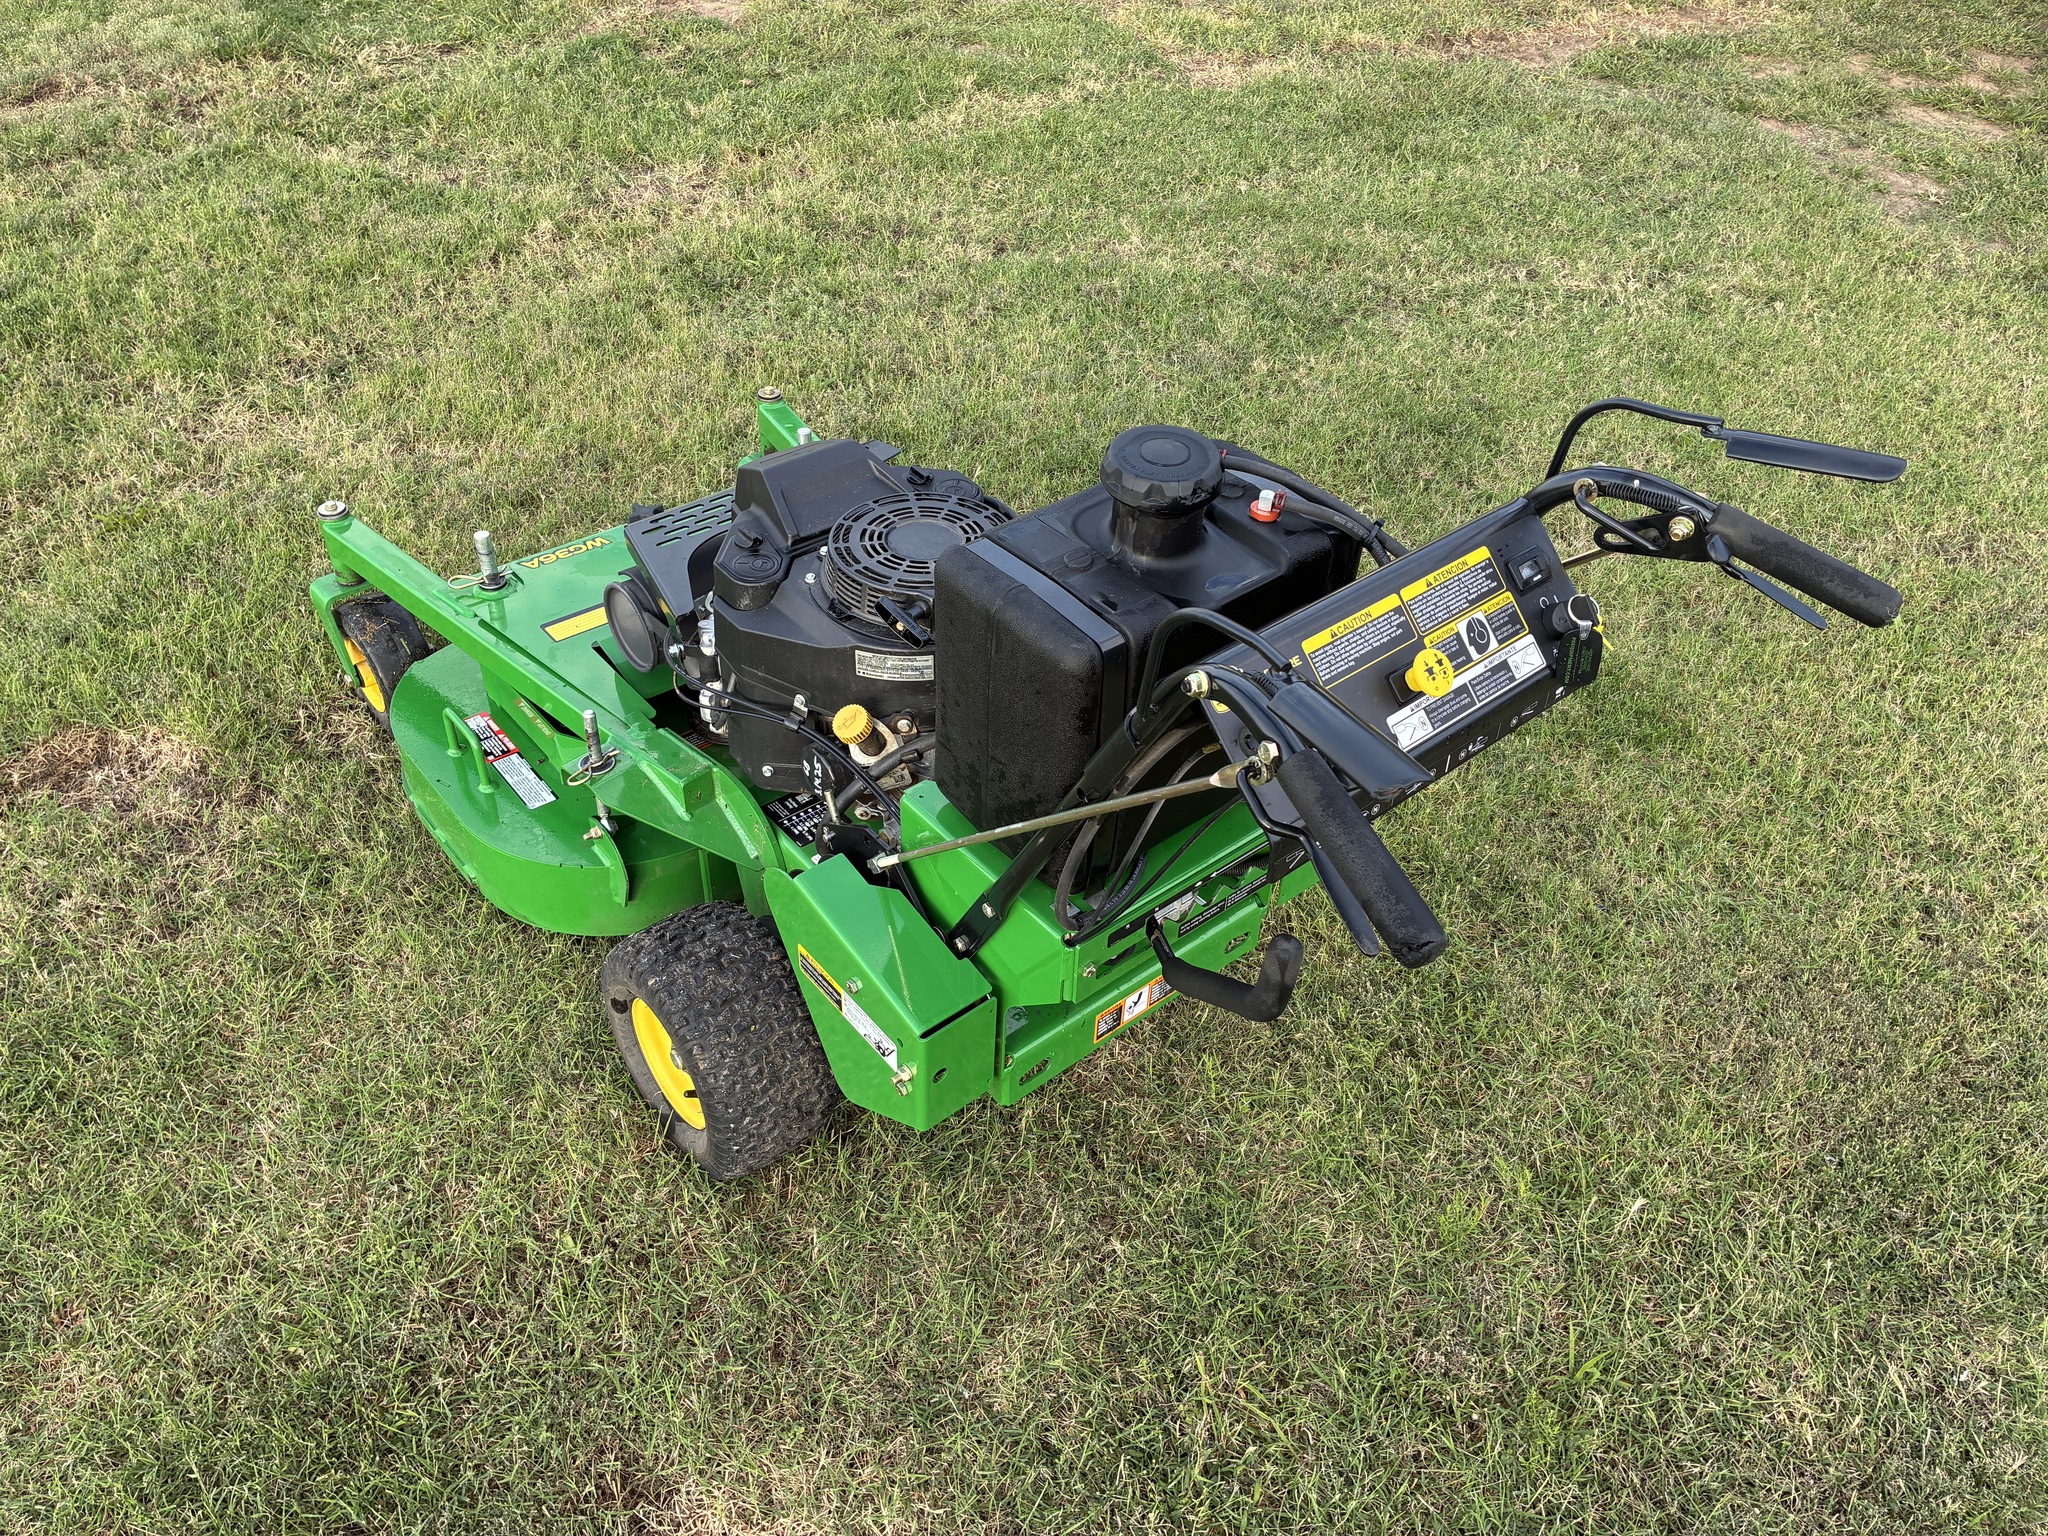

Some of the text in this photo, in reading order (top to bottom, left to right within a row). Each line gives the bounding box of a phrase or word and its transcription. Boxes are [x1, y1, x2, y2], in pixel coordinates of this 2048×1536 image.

[517, 537, 611, 569] WG36A
[1433, 560, 1468, 583] ATENCION
[1487, 595, 1510, 610] ATENCION
[1337, 610, 1372, 634] CAUTION
[1432, 627, 1455, 642] CAUTION
[1487, 645, 1517, 666] IMPORTANTE
